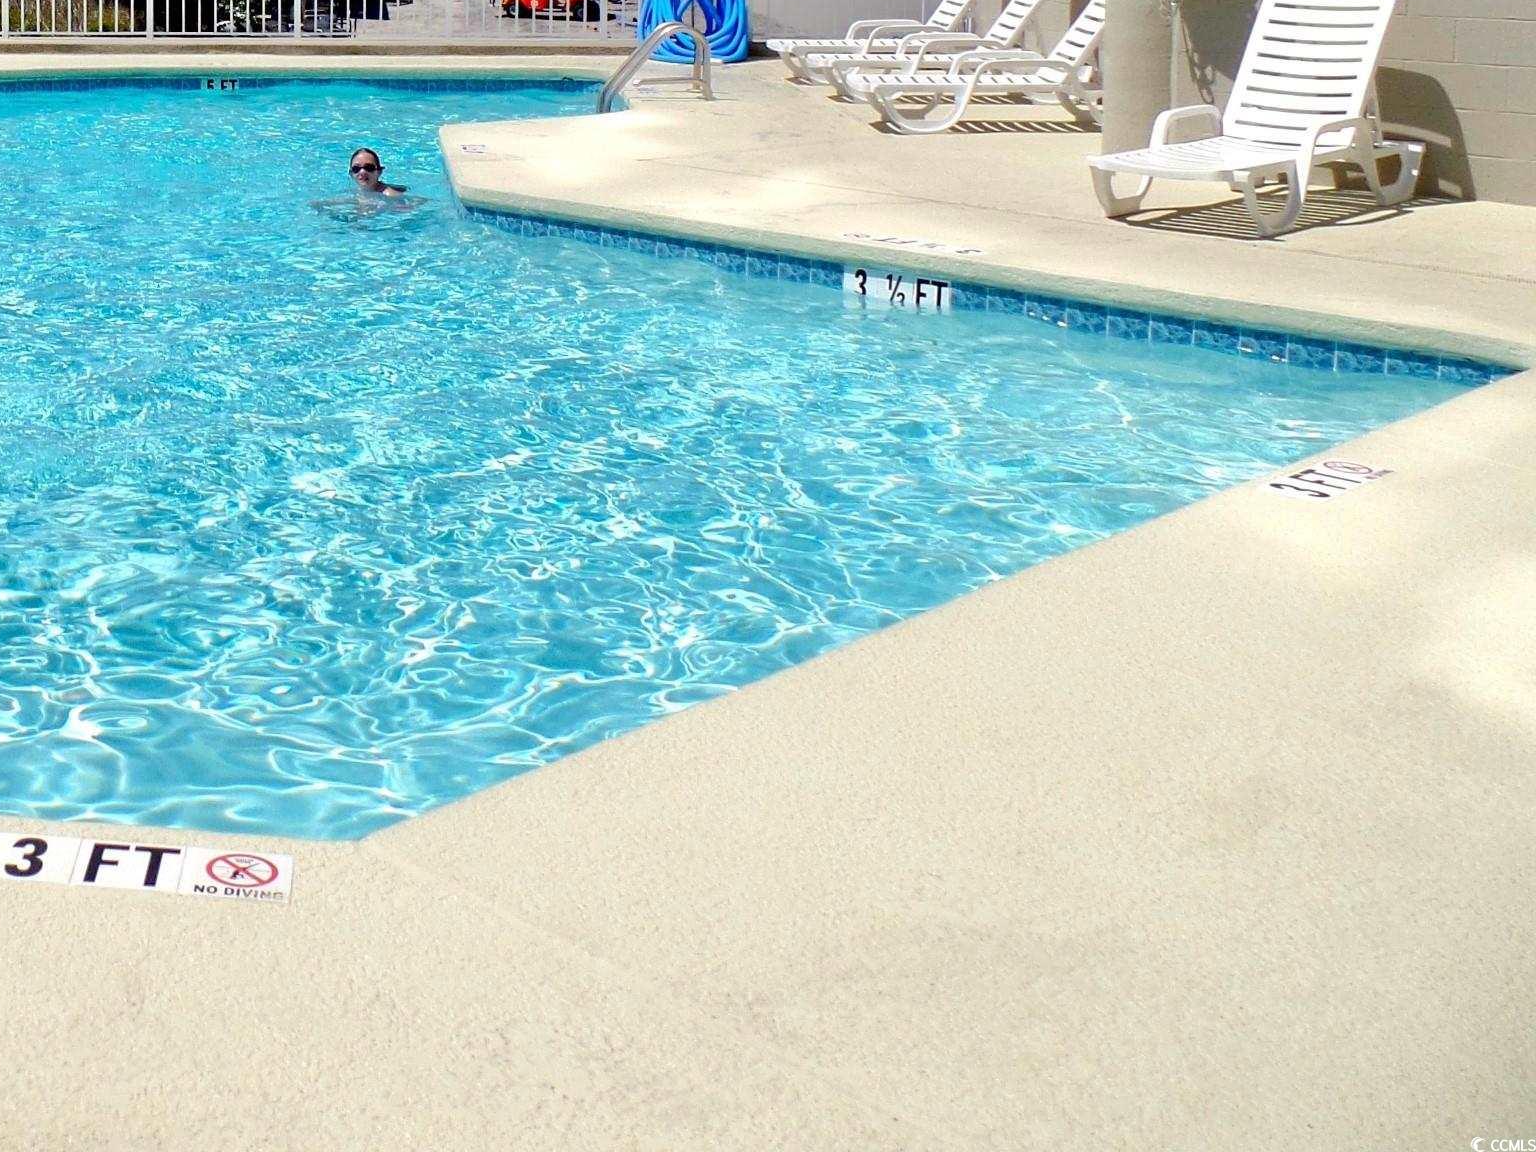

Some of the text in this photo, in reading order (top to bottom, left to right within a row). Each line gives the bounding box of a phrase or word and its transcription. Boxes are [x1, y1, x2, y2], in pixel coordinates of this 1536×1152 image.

[915, 278, 949, 309] FT
[4, 837, 182, 887] 3 FT
[193, 884, 285, 901] NO DIVING
